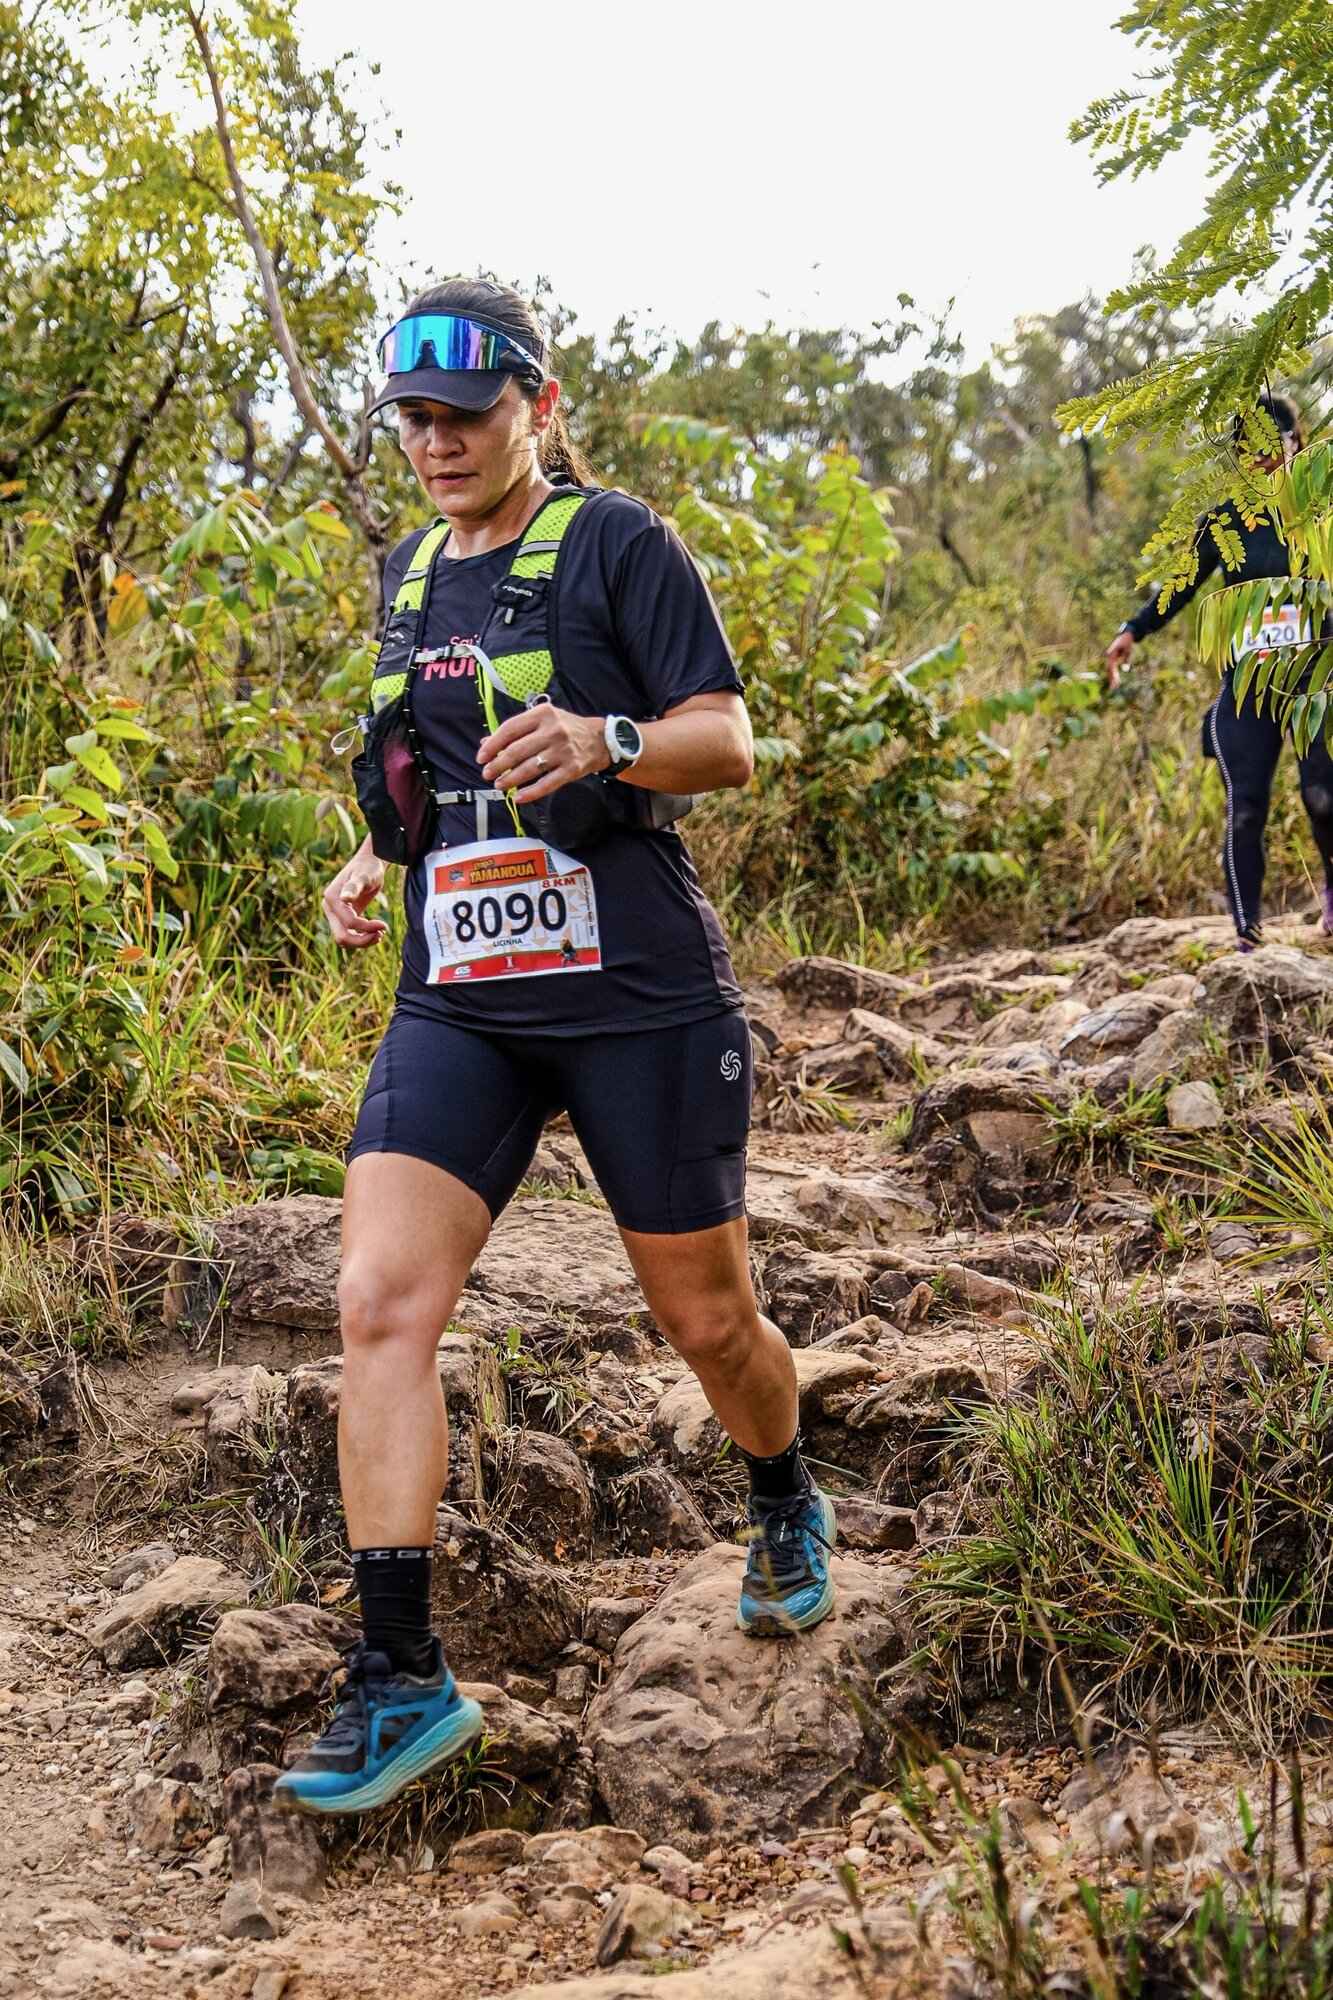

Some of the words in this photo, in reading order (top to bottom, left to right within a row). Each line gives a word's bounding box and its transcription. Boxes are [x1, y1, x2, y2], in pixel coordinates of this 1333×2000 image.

[541, 879, 550, 888] 8
[553, 876, 577, 887] KM
[452, 888, 567, 943] 8090
